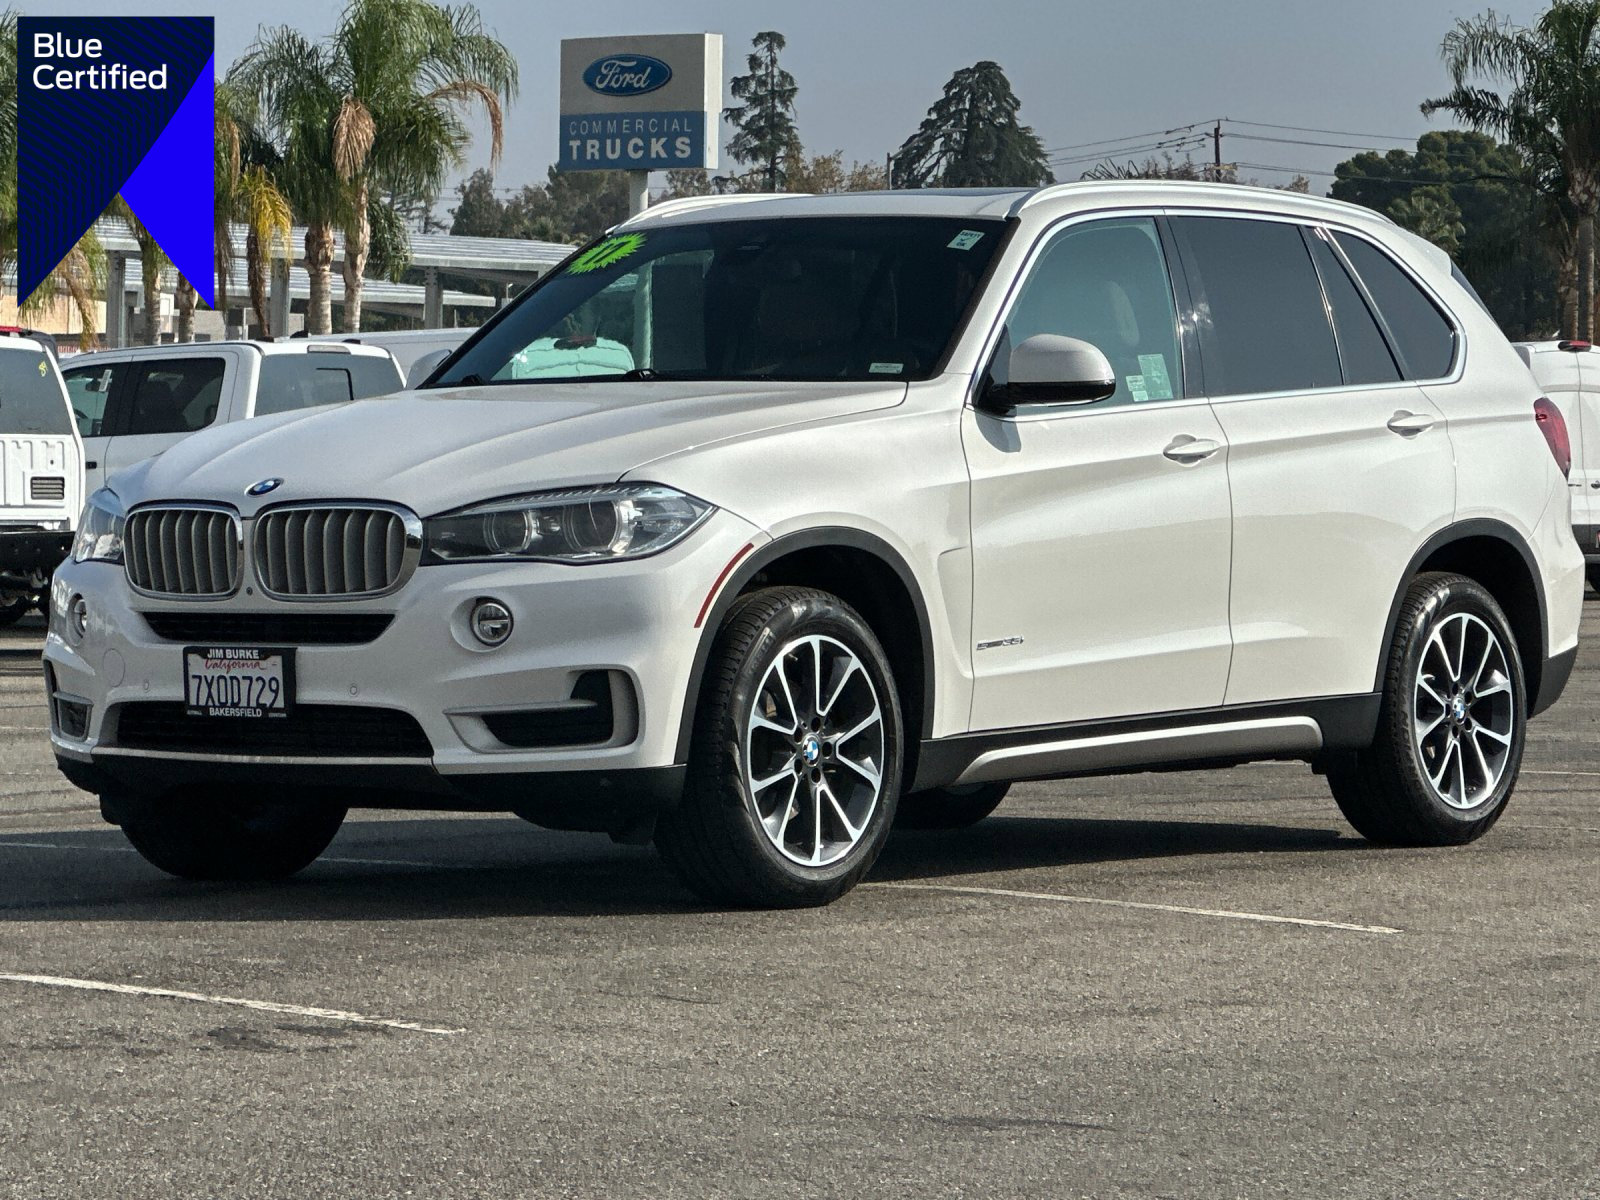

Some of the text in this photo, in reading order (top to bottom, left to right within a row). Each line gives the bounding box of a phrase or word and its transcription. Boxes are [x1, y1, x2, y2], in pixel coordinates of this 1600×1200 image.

[595, 60, 651, 88] Ford
[569, 118, 692, 135] COMMERCIAL
[569, 137, 691, 161] TRUCKS
[207, 648, 260, 660] JIM BURKE
[204, 659, 262, 674] California
[209, 707, 262, 718] BAKERSFIELD
